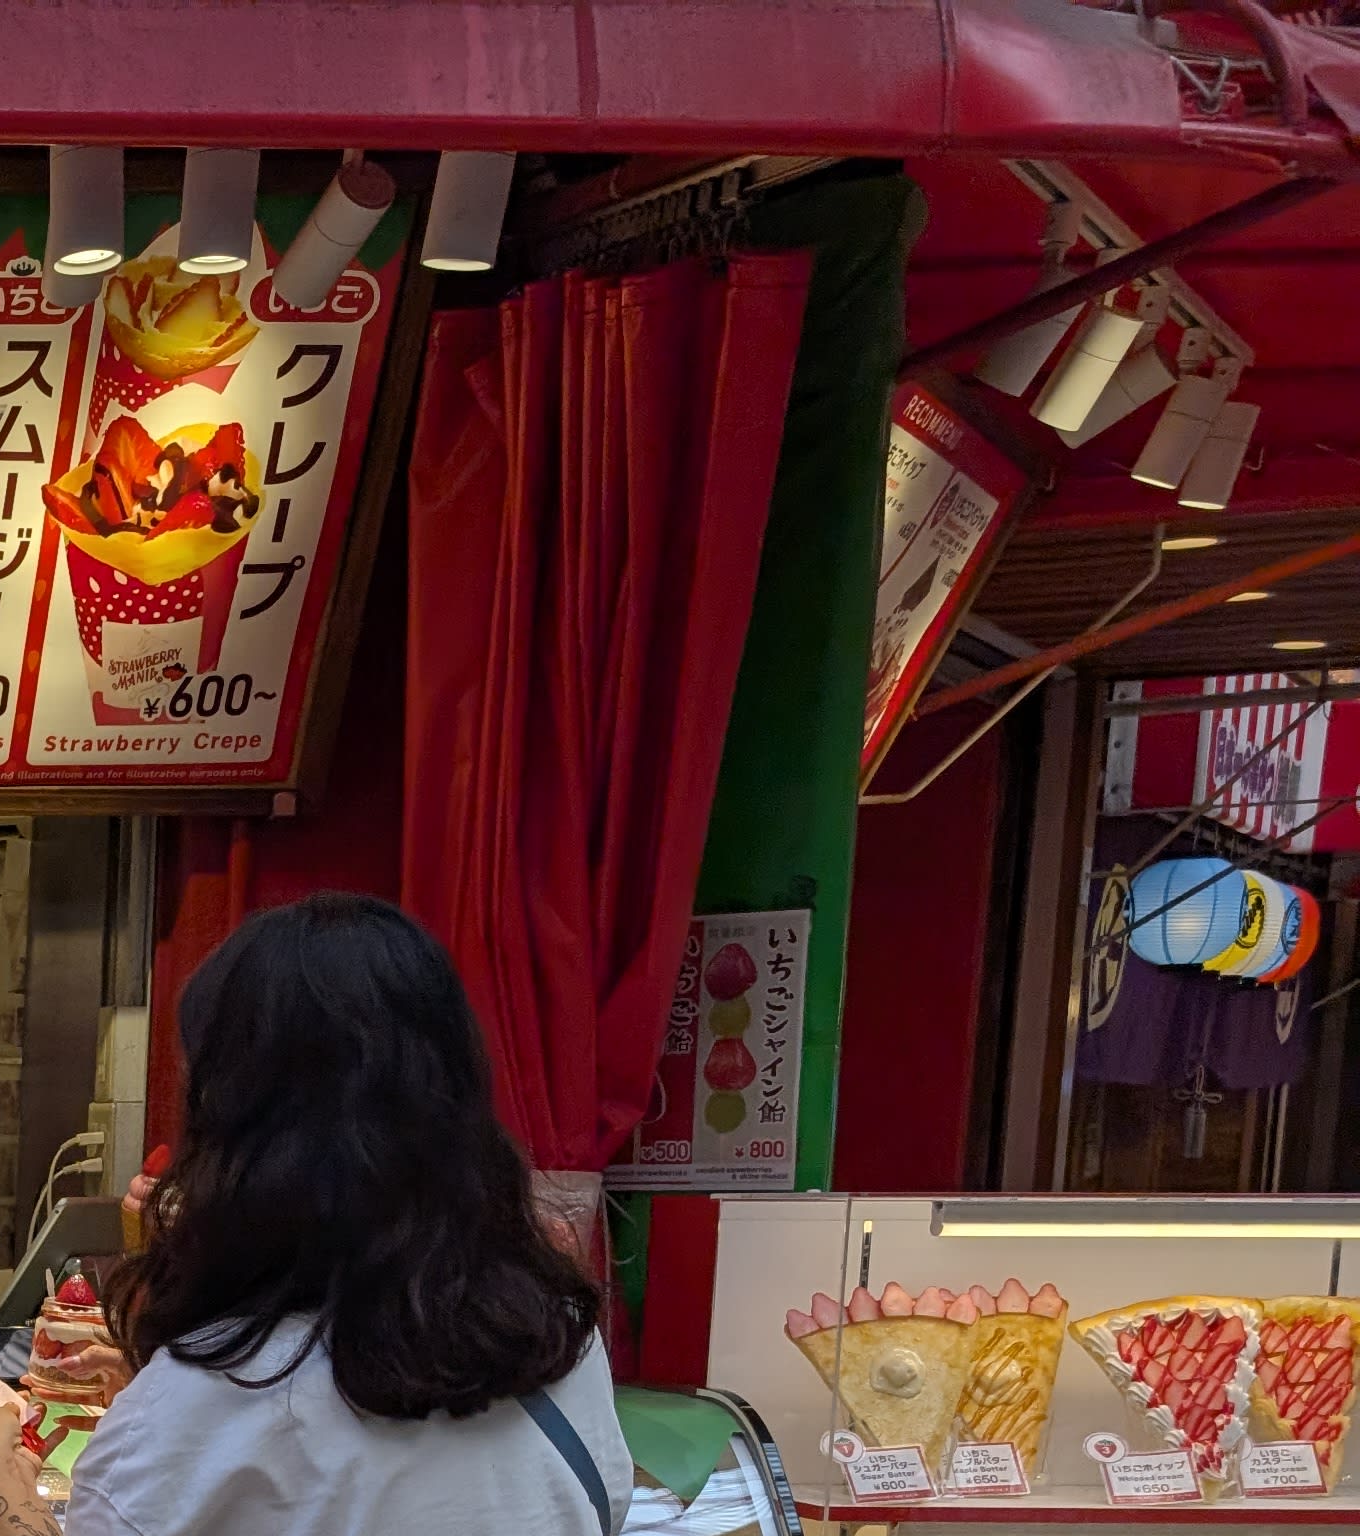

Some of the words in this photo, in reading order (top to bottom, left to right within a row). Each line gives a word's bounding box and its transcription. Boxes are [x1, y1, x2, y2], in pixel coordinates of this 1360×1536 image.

[240, 344, 343, 620] クレープ
[44, 735, 180, 754] Strawberry
[194, 734, 262, 752] Crepe
[757, 928, 797, 1123] いちごシャイン飴
[735, 1141, 784, 1158] ¥800
[1112, 1461, 1185, 1473] いちごホイップ
[1251, 1456, 1302, 1466] カスタード
[874, 1480, 907, 1490] ¥600
